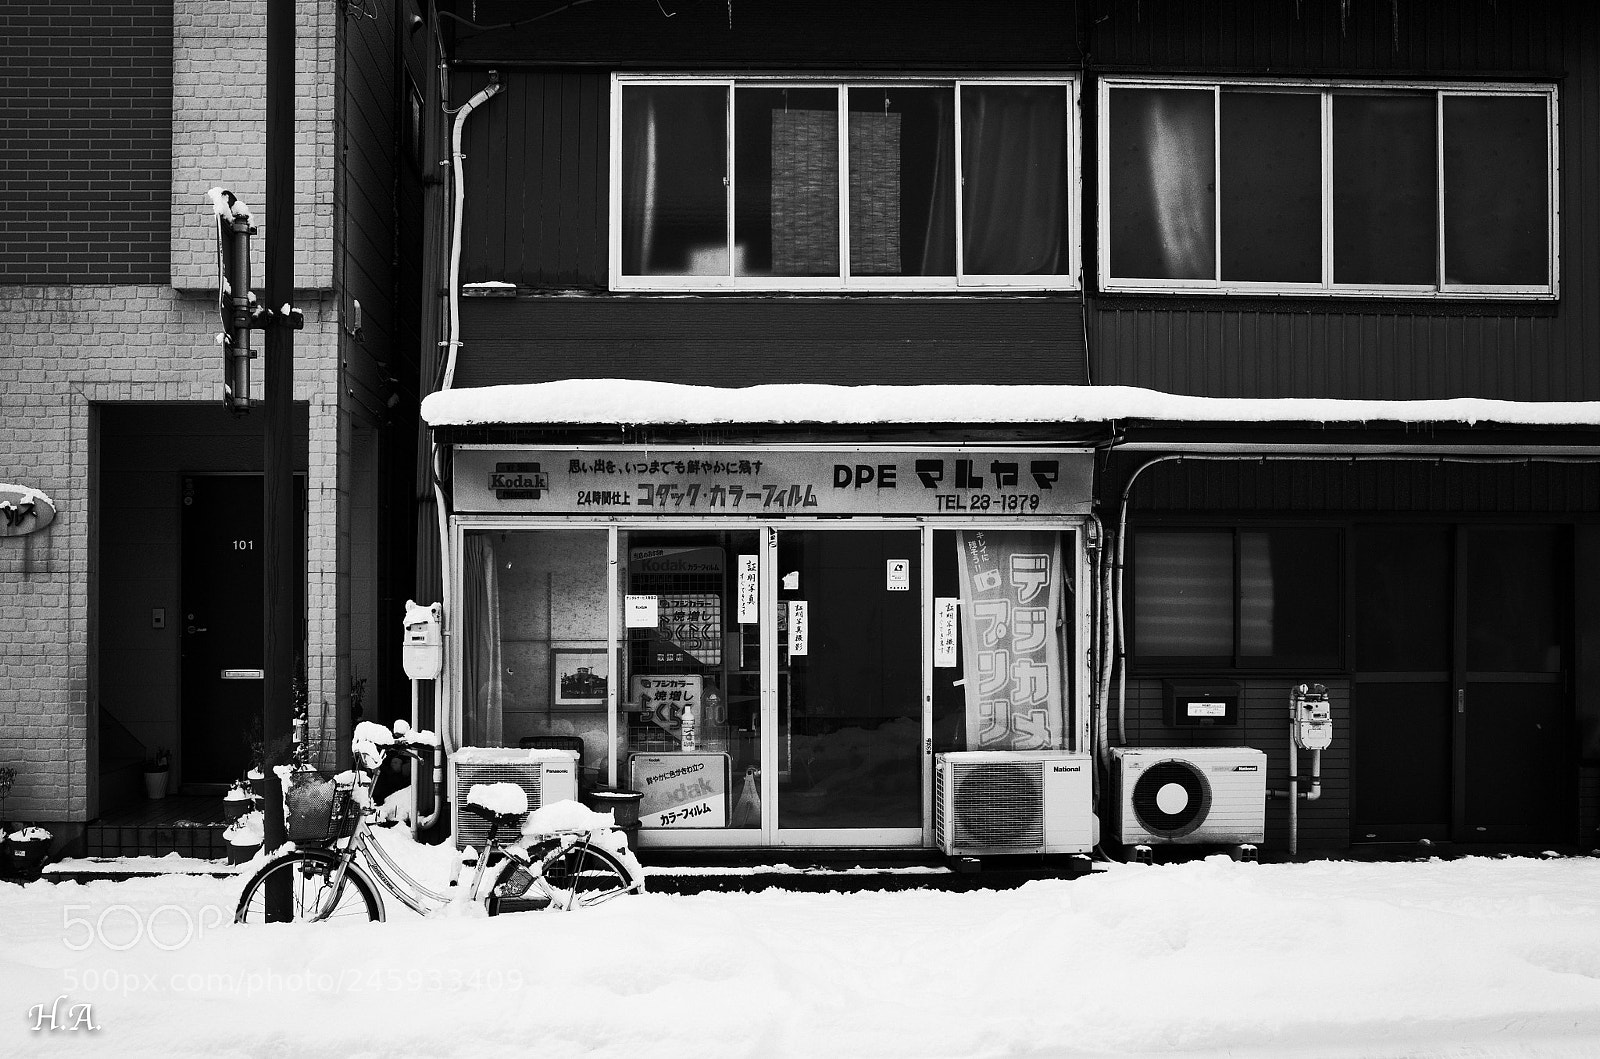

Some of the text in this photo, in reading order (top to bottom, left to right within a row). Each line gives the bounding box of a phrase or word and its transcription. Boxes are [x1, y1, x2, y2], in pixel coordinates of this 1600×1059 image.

[568, 459, 764, 475] 思い出を、いつまでも鮮やかに残す
[915, 459, 1060, 490] マルヤマ
[491, 474, 546, 488] Kodak
[833, 464, 897, 489] DPE
[576, 490, 631, 506] 24時間仕上
[935, 494, 1040, 511] TEL 23-1379
[232, 539, 254, 551] 101
[976, 531, 990, 562] キレイに
[642, 558, 720, 572] Kodak カラーフィルム
[745, 559, 757, 606] 証明写真
[672, 610, 712, 622] 焼増し
[659, 615, 713, 650] らくらく
[794, 604, 804, 652] 証明写真撮影
[945, 602, 955, 654] 証明写真撮影
[1009, 553, 1052, 750] デジカメ
[652, 680, 694, 688] フジカラー
[653, 690, 695, 702] 焼増し
[1053, 765, 1081, 773] National
[660, 802, 712, 827] カラーフィルム
